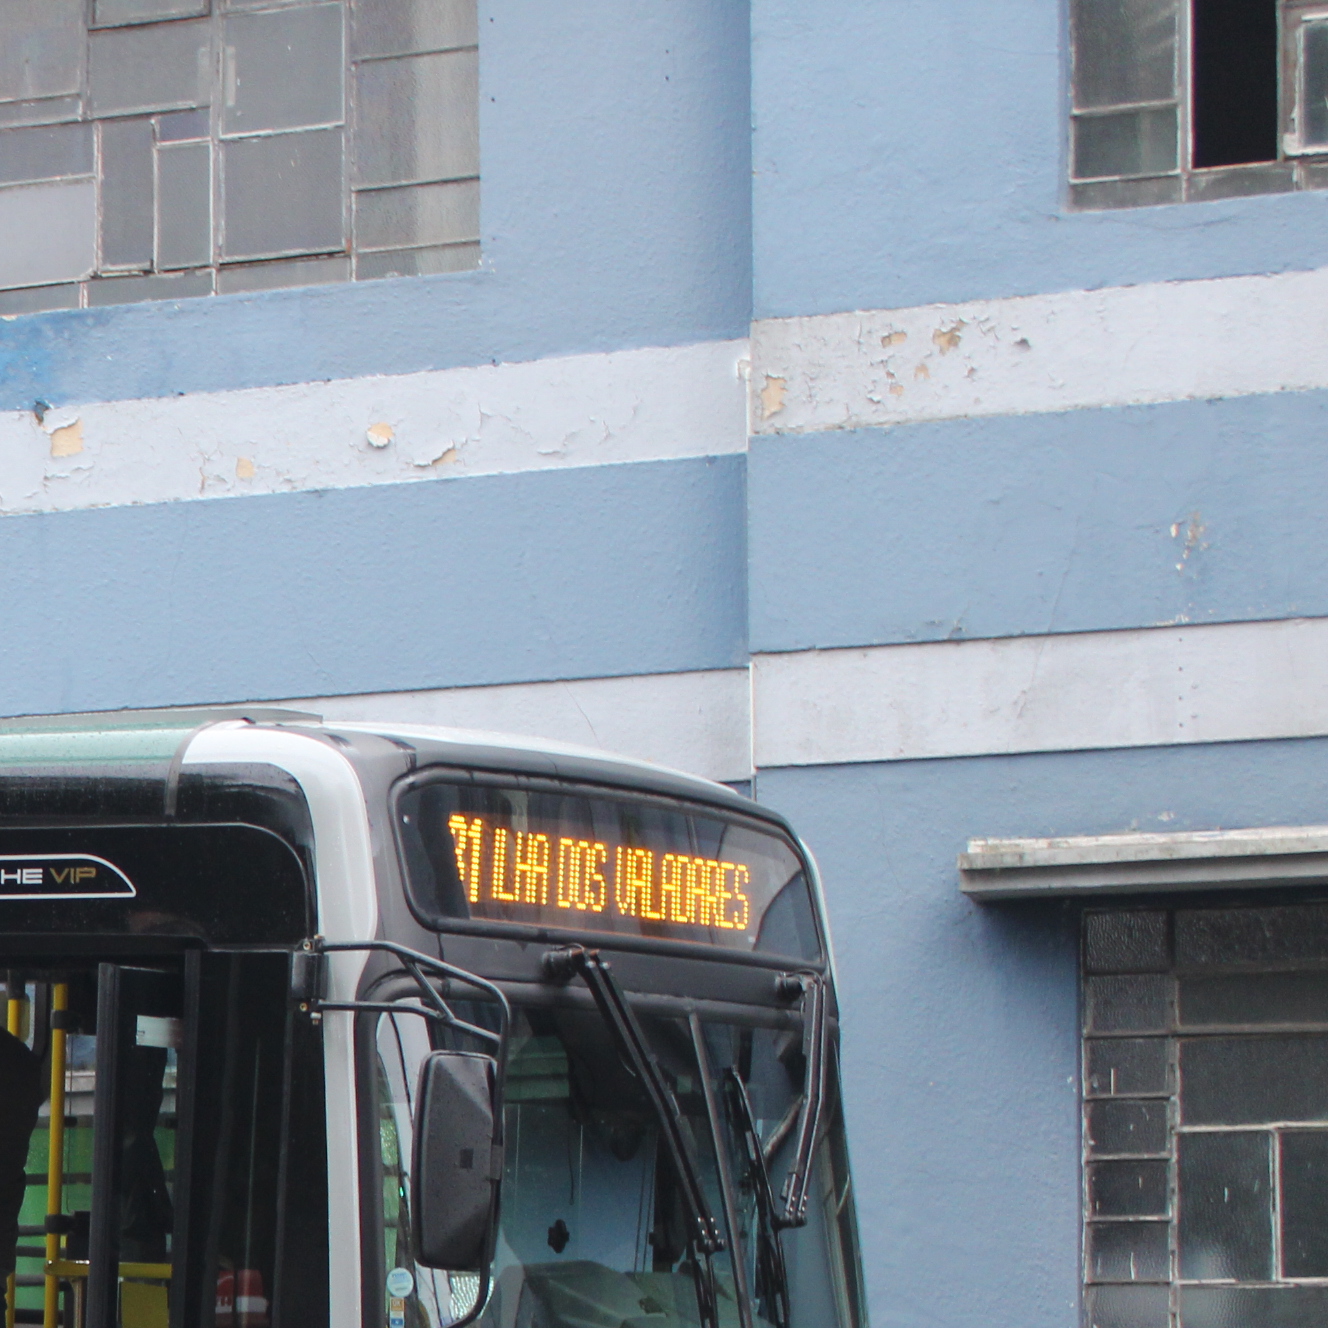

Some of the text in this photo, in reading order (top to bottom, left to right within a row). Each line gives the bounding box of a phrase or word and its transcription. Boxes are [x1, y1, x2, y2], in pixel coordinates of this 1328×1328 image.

[49, 866, 98, 884] VIP
[492, 826, 549, 907] ILHA
[557, 836, 607, 912] DOS
[615, 845, 751, 930] VALADARES
